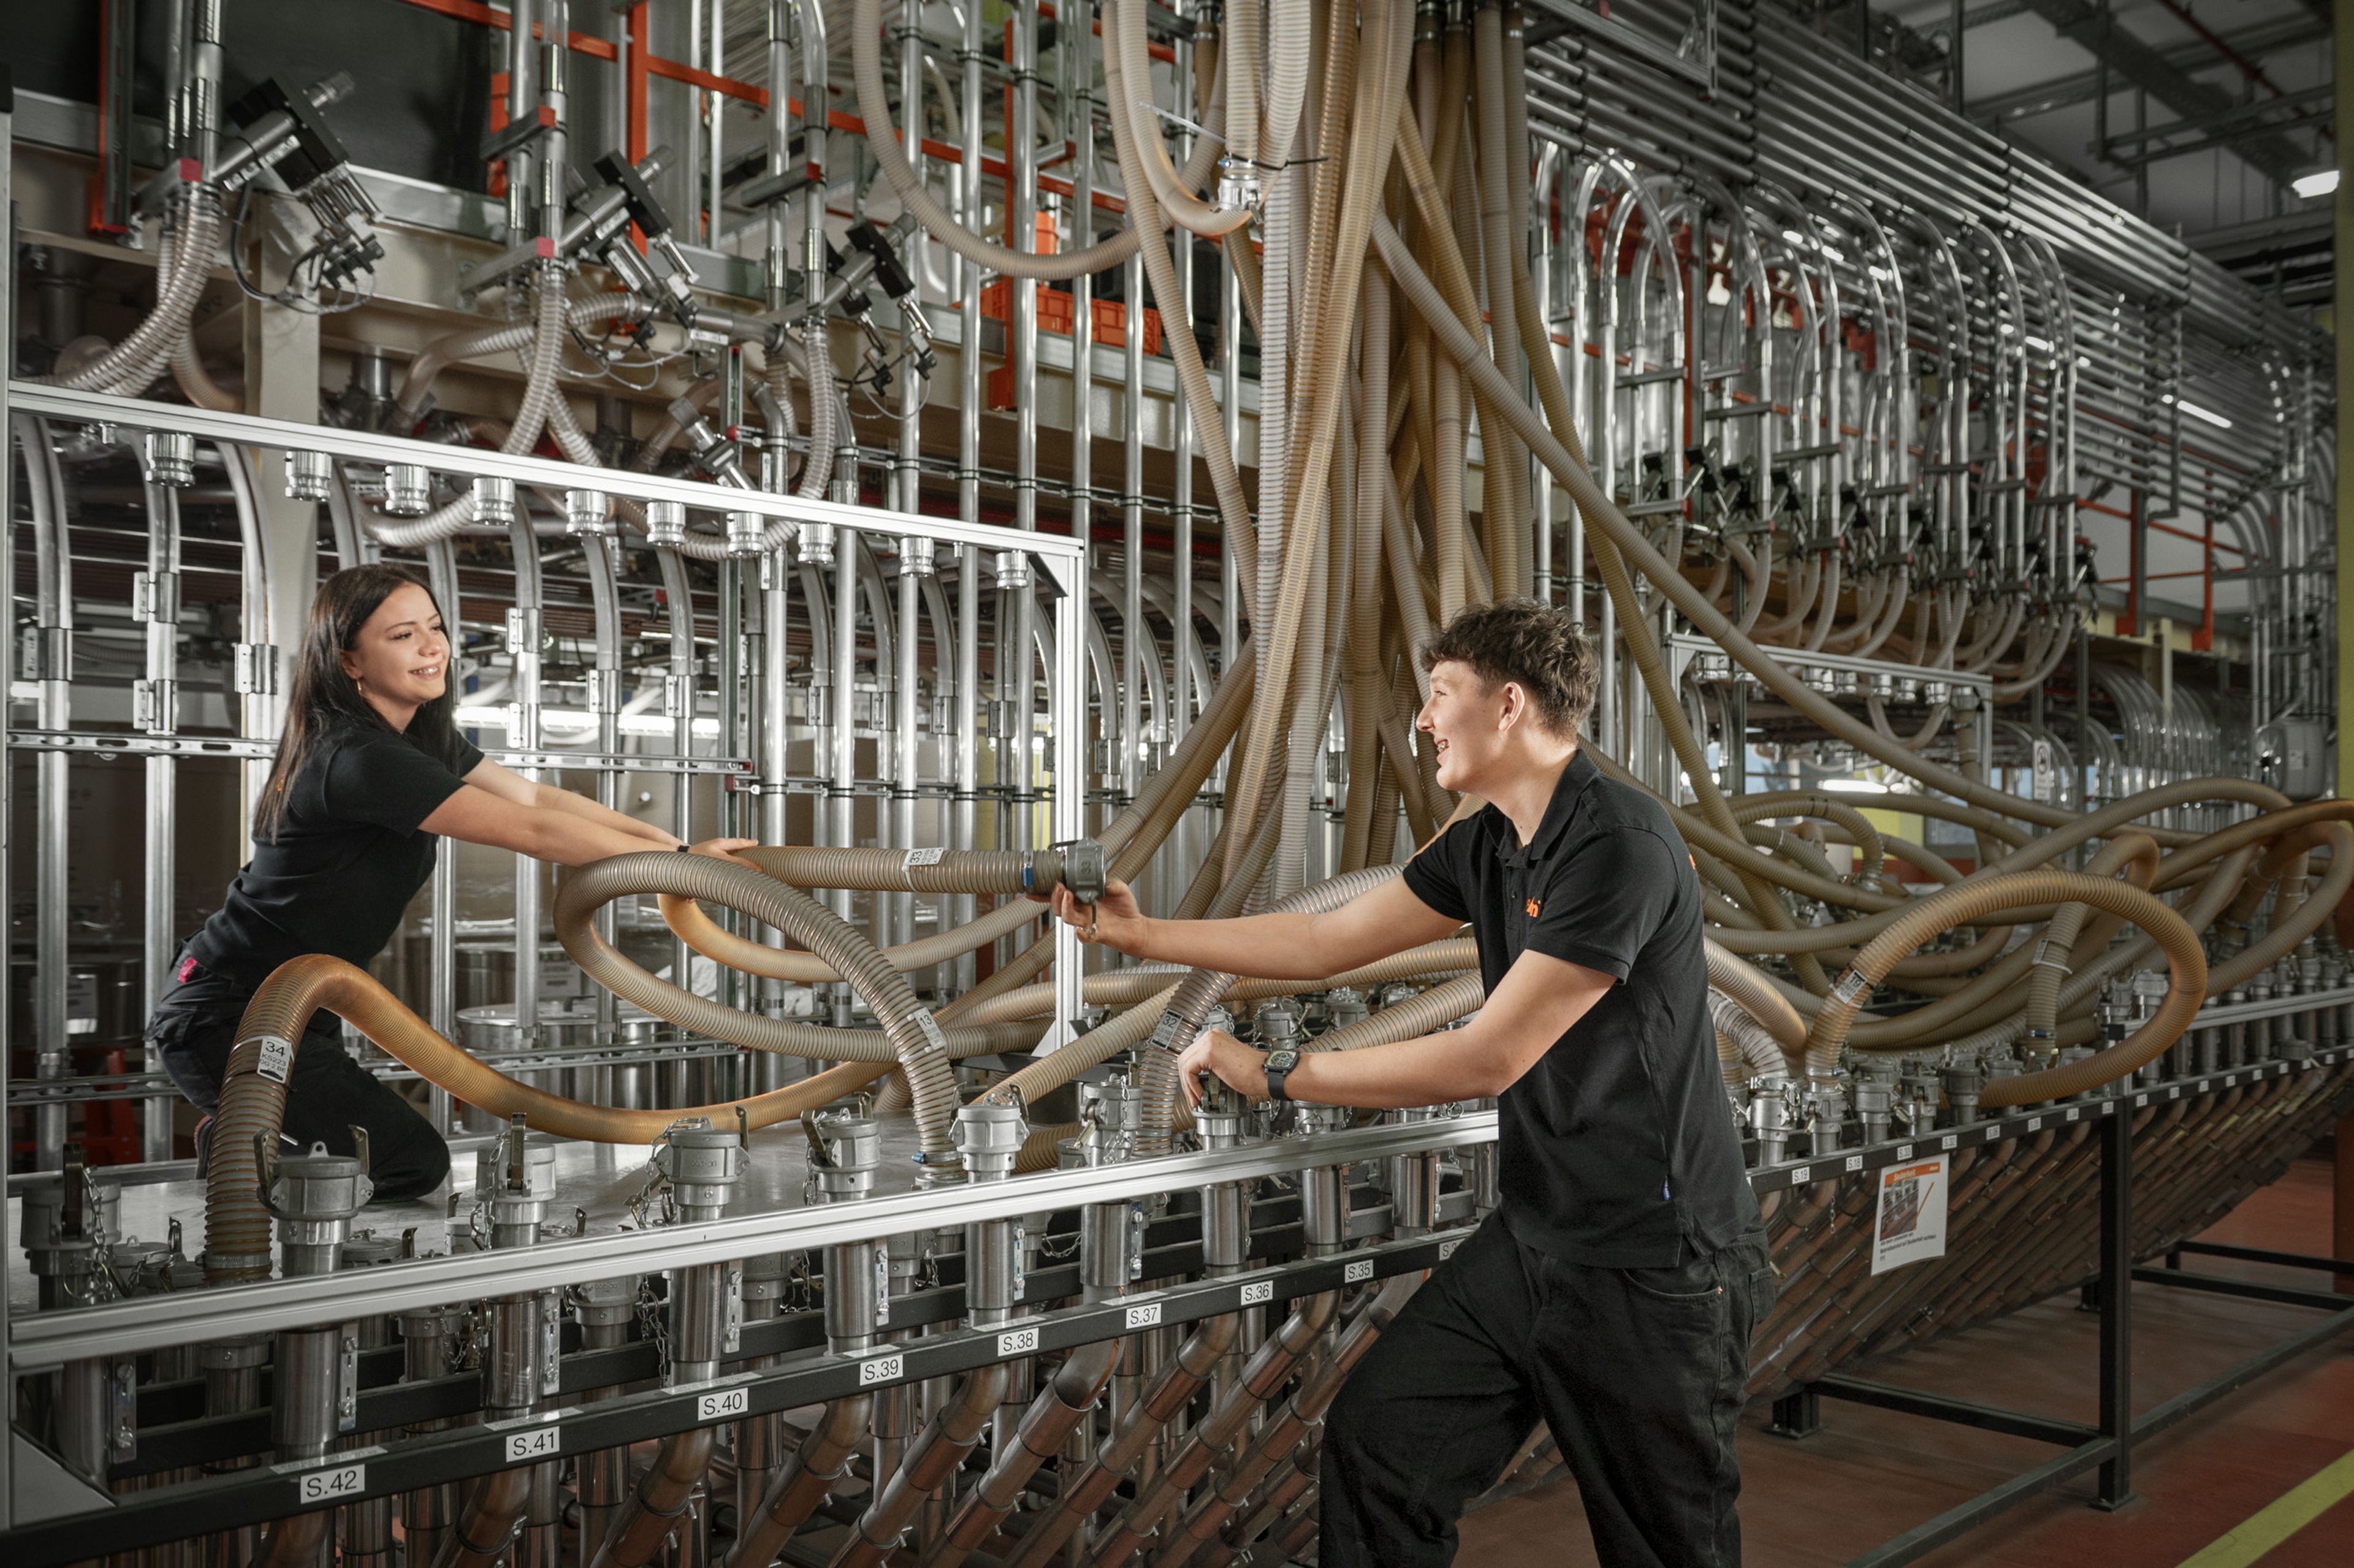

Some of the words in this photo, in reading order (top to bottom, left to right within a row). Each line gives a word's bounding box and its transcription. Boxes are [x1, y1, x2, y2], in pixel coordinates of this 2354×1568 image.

[910, 851, 922, 863] 33
[920, 1014, 932, 1026] 13
[1162, 1016, 1177, 1029] 32
[265, 1041, 285, 1057] 34
[1848, 1157, 1861, 1169] S.18
[1794, 1170, 1808, 1182] S.19
[1348, 1262, 1371, 1279] S.35
[1244, 1284, 1270, 1301] S.36
[1130, 1307, 1158, 1325] S.37
[1003, 1332, 1034, 1352] S.38
[864, 1359, 899, 1380] S.39
[704, 1393, 742, 1415] S.40
[513, 1431, 554, 1456] S.41
[307, 1470, 357, 1498] S.42
